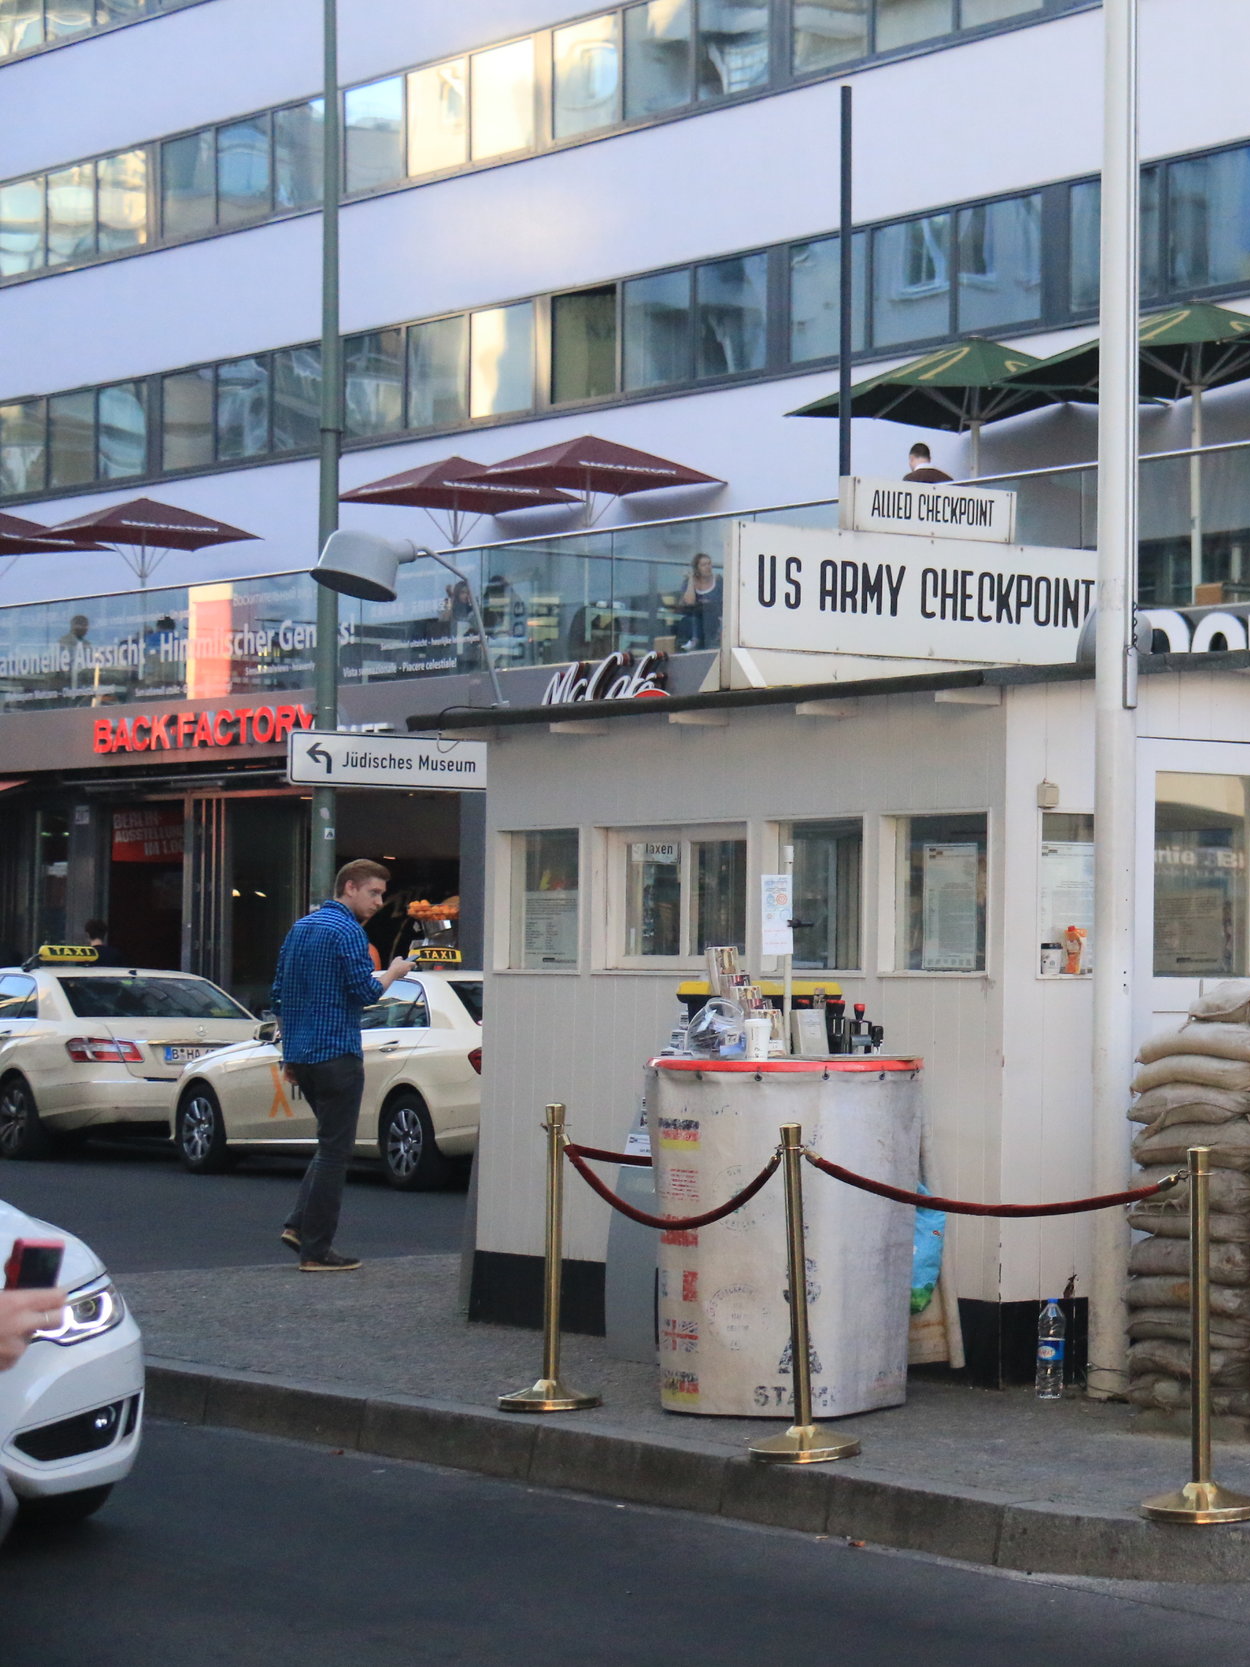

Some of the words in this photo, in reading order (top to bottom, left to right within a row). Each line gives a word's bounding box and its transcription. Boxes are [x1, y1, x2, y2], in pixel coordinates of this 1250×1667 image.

[872, 489, 911, 520] ALLIED
[918, 494, 995, 527] CHECKPOINT
[758, 553, 802, 609] US
[819, 559, 907, 616] ARMY
[920, 567, 1095, 628] CHECKPOINT
[73, 636, 146, 671] Aussicht
[342, 751, 413, 771] Jüdisches
[418, 754, 476, 773] Museum
[424, 951, 453, 959] TAXI
